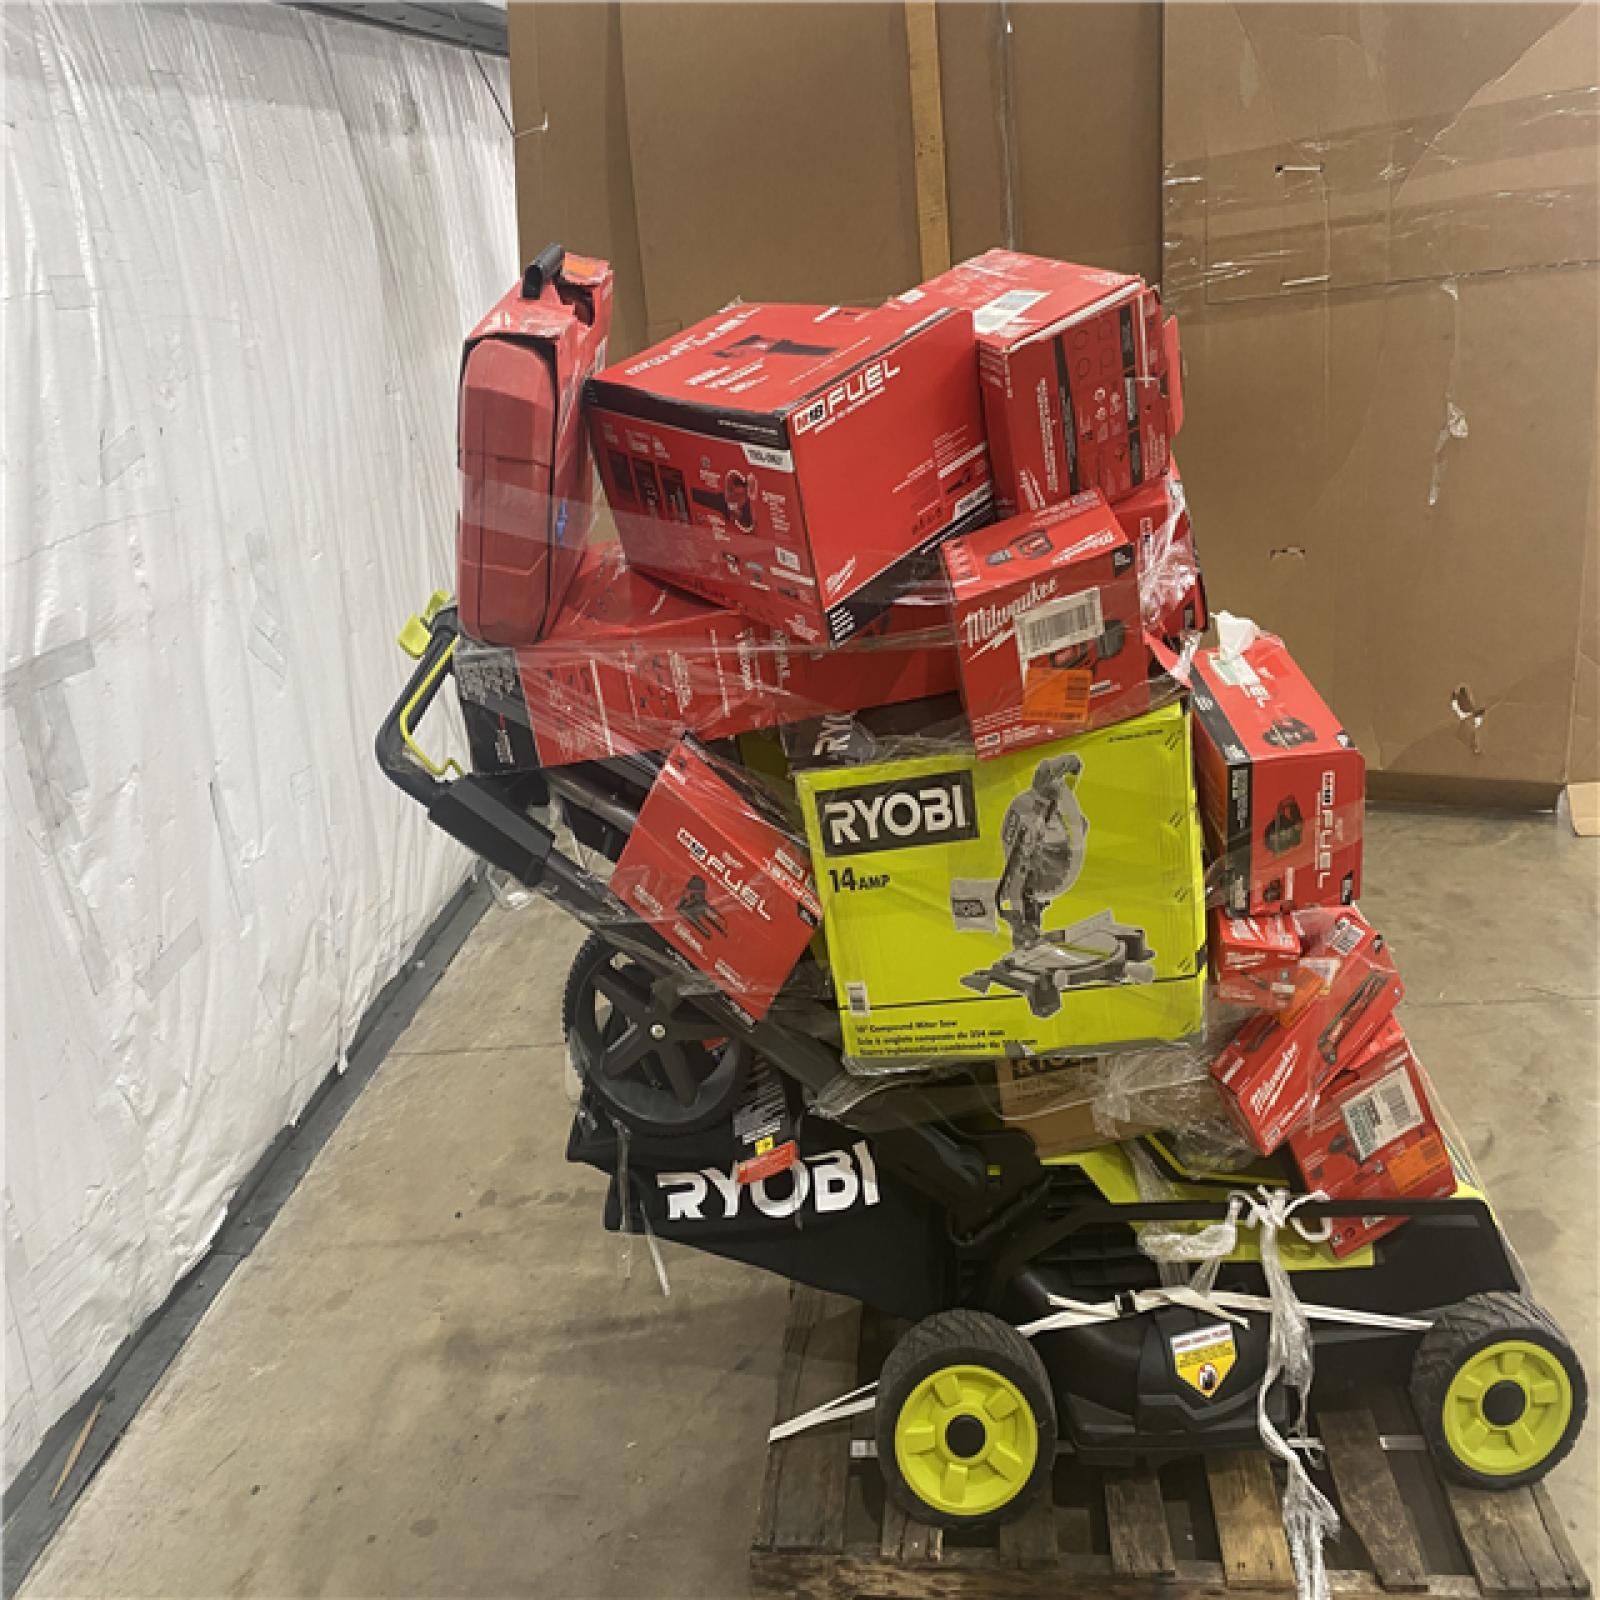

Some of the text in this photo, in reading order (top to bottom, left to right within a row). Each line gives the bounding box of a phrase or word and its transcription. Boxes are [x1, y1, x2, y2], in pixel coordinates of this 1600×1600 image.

[828, 359, 901, 416] FUEL
[959, 576, 1057, 648] Milwaukee
[824, 784, 968, 846] RYOBI
[828, 868, 857, 894] 14
[858, 874, 891, 892] AMP
[1317, 809, 1335, 889] FUEL
[706, 854, 772, 921] FUEL
[656, 1139, 881, 1221] RYOBI
